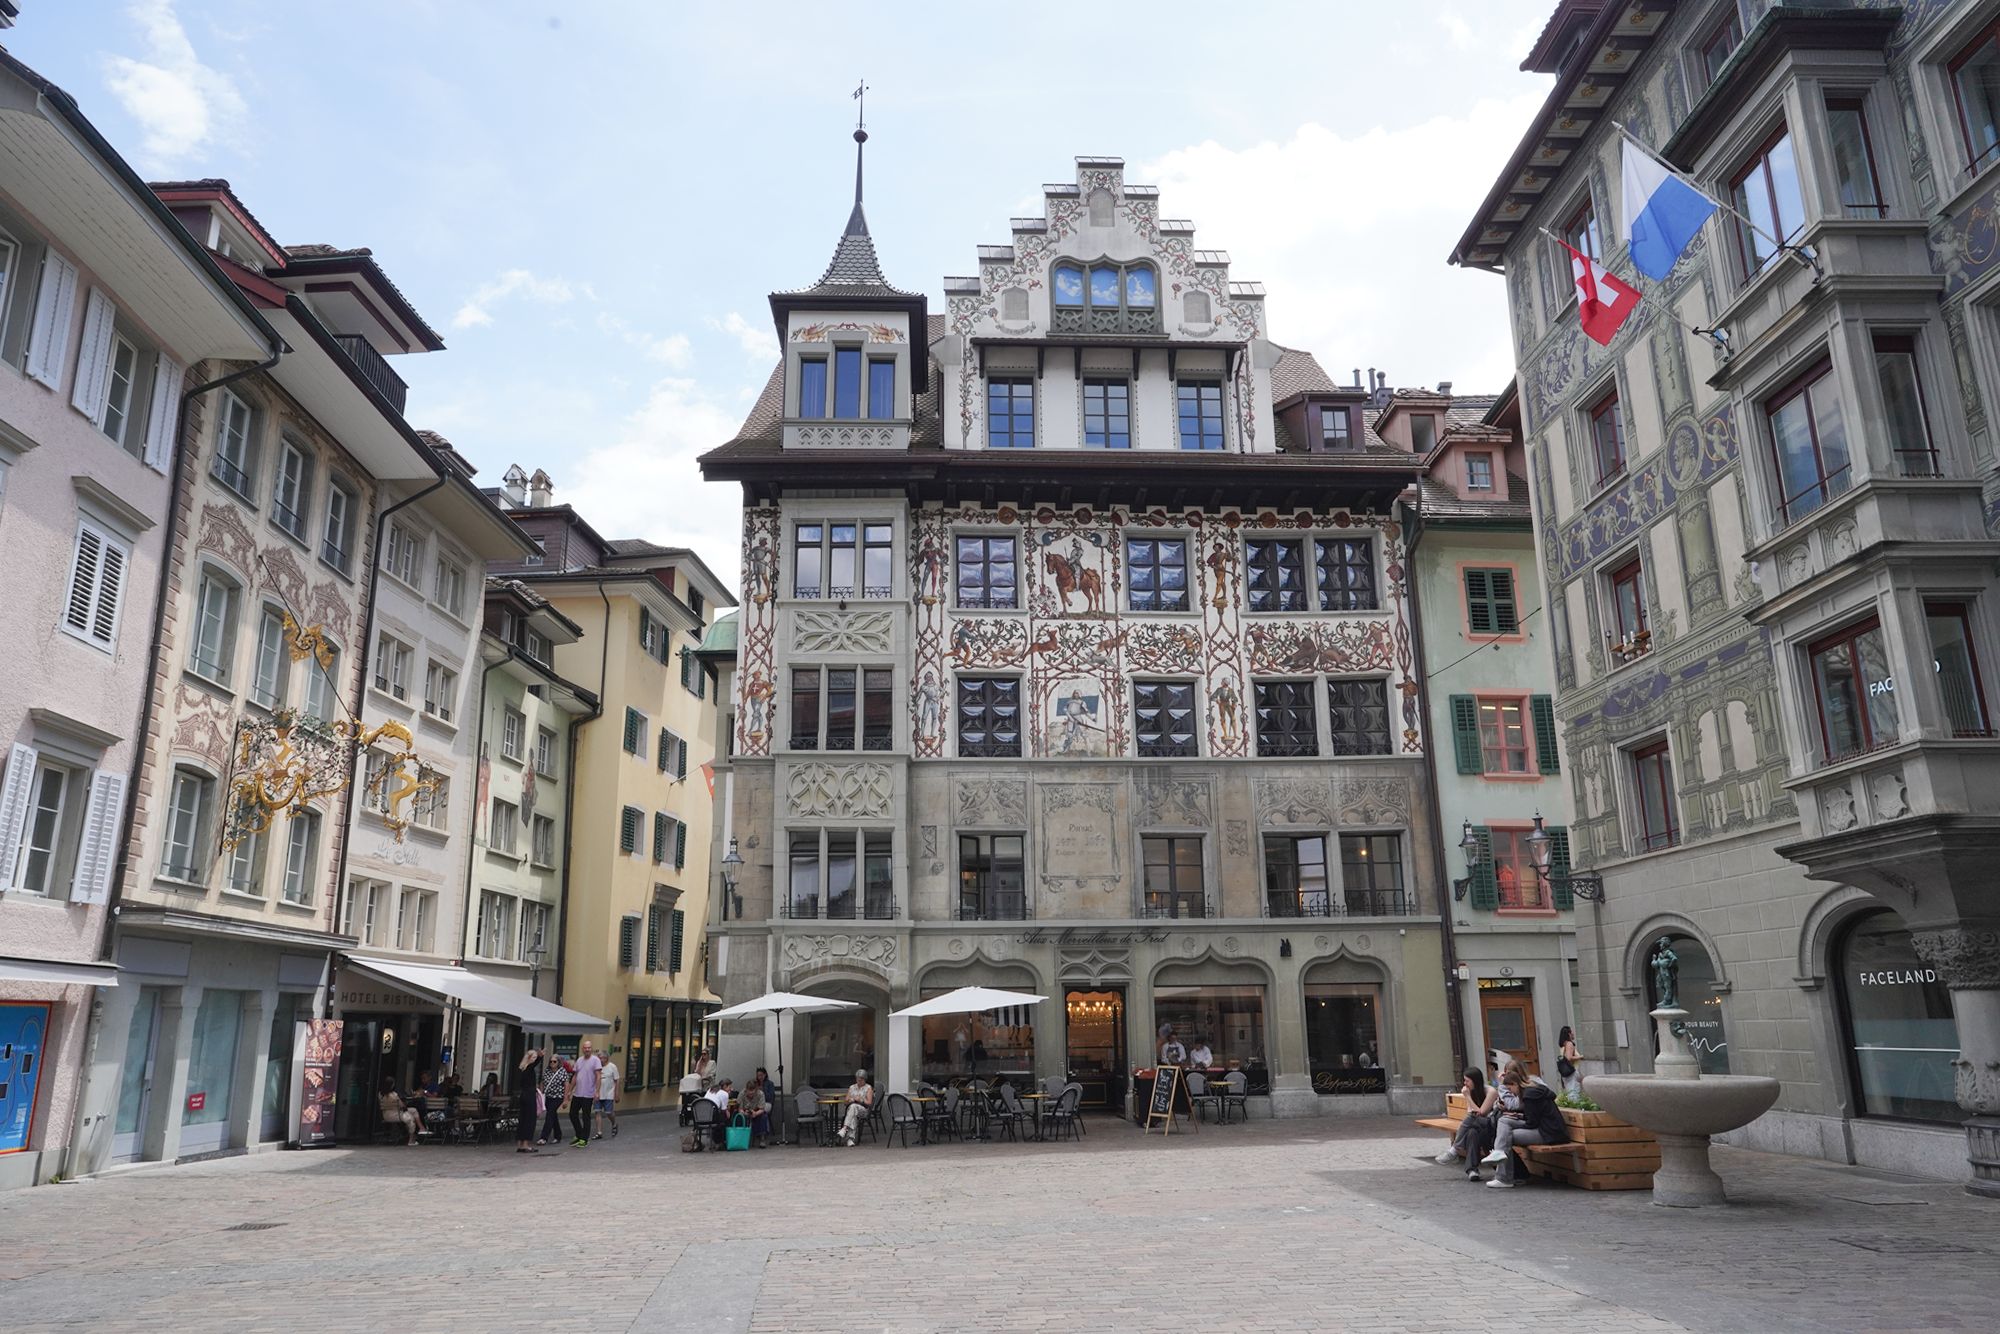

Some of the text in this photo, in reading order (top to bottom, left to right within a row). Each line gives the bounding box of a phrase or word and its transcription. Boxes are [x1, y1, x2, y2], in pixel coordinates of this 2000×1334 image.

[1016, 927, 1046, 945] Aux
[1120, 932, 1132, 945] de
[1860, 969, 1936, 986] FACELAND
[341, 992, 445, 1007] HOTEL RISTORA
[1699, 1020, 1719, 1028] BEAUTY
